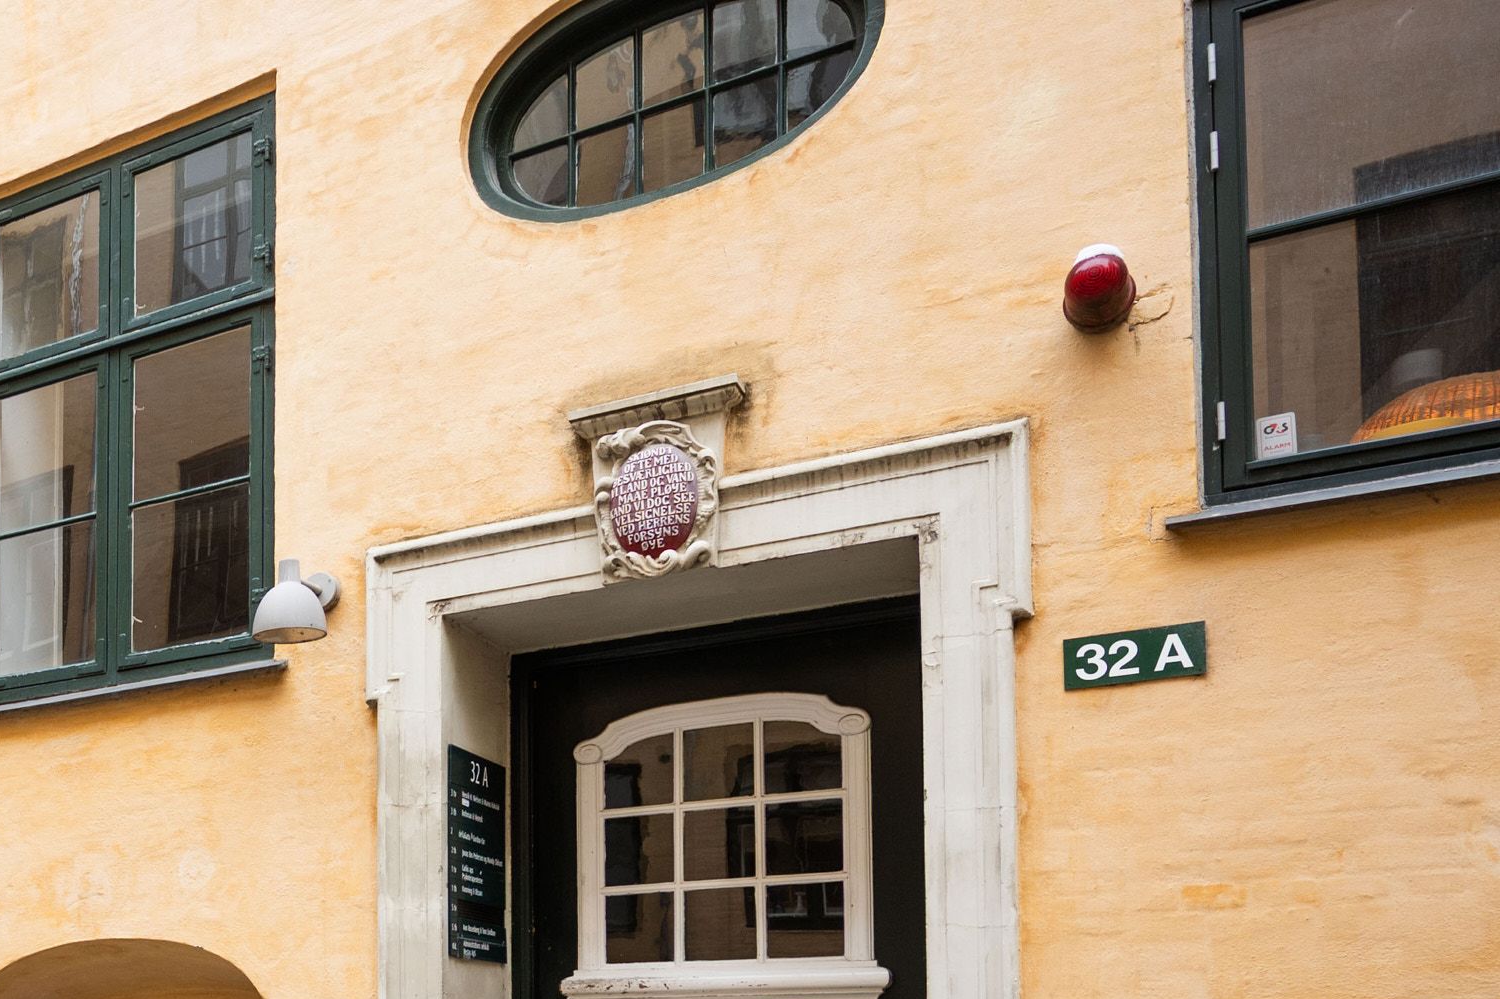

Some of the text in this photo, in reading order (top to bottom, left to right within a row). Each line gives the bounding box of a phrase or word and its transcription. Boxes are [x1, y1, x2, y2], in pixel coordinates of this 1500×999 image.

[1264, 442, 1291, 451] ALARM
[624, 454, 678, 473] OFTE MED
[618, 482, 687, 505] MAAE PLØYE
[620, 480, 648, 495] LAND
[666, 471, 695, 484] VAND
[633, 500, 645, 511] VI
[673, 492, 696, 504] SEE
[616, 514, 691, 537] VED HERRENS
[627, 525, 679, 545] FORSYNS
[641, 538, 665, 551] ØYE
[1075, 633, 1194, 681] 32 A
[470, 760, 489, 788] 32 A
